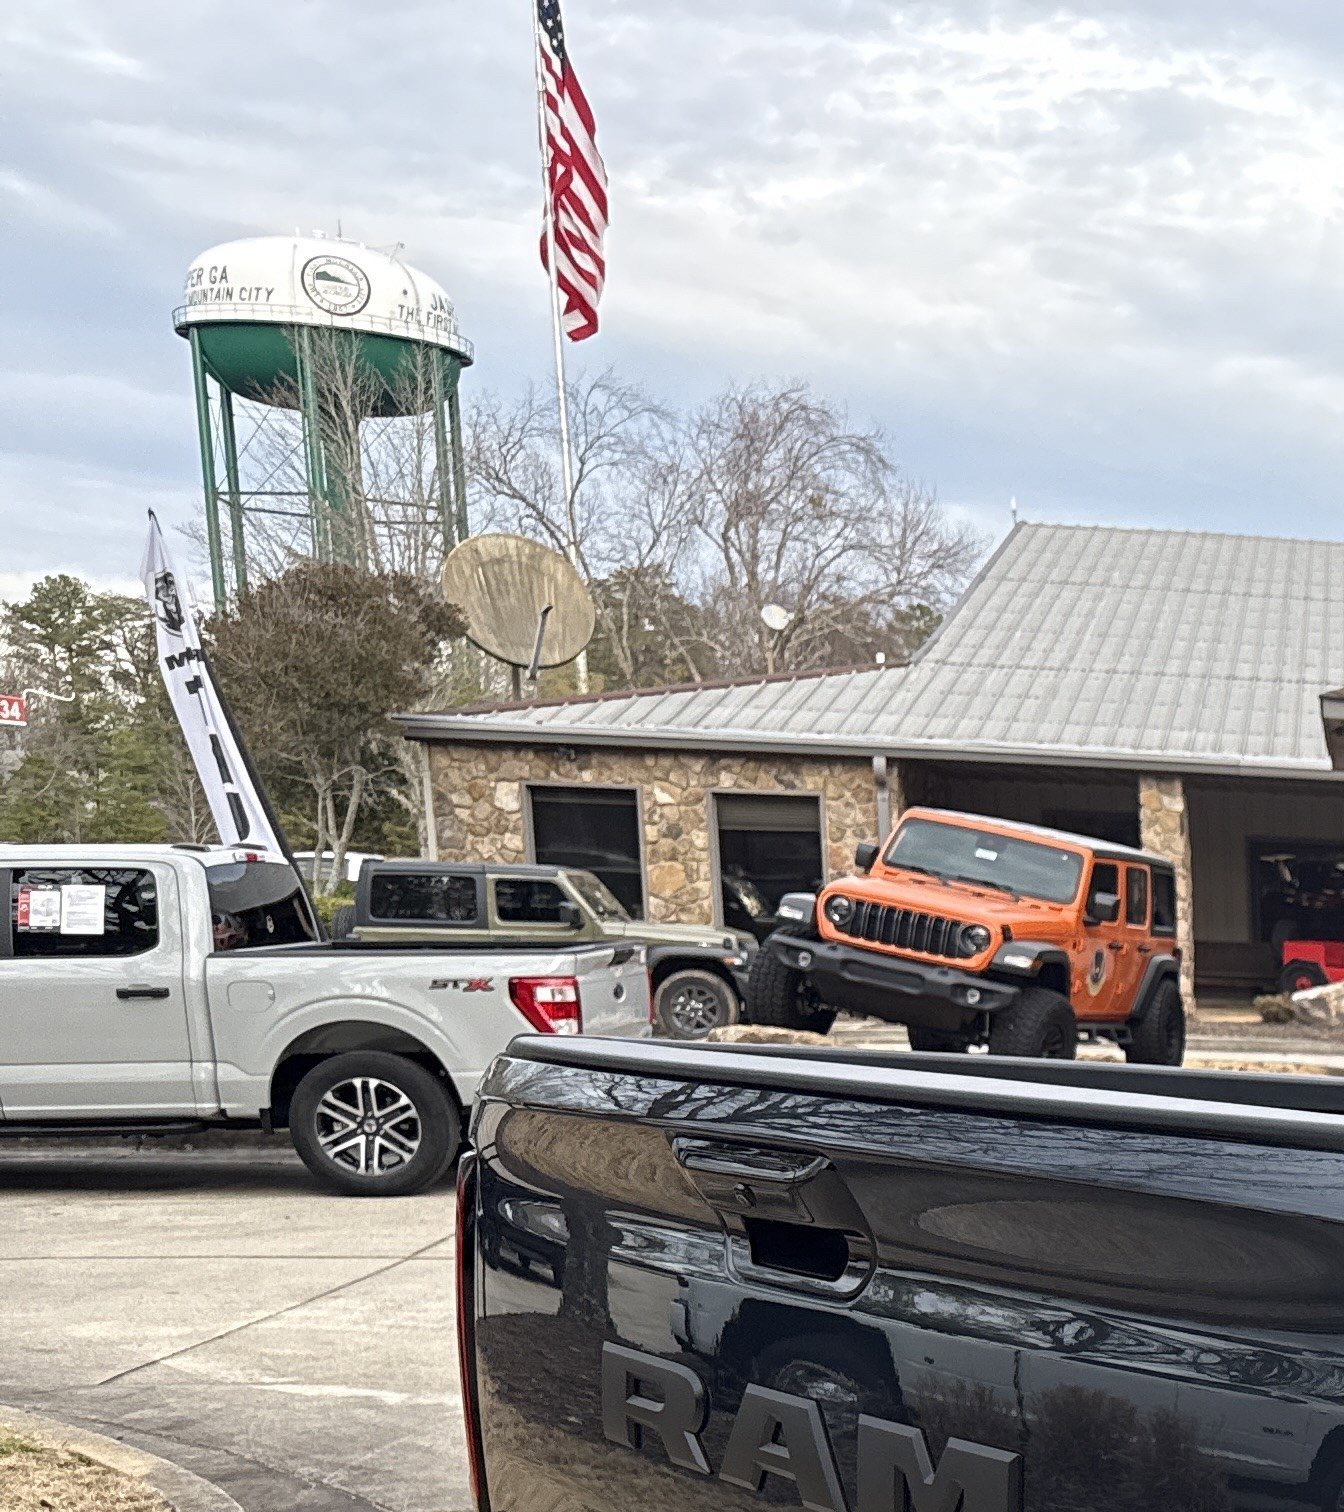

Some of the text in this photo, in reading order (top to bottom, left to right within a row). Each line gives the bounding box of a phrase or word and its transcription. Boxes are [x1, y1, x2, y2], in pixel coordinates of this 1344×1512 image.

[209, 265, 229, 284] GA
[239, 286, 275, 302] CITY
[429, 976, 495, 992] STX
